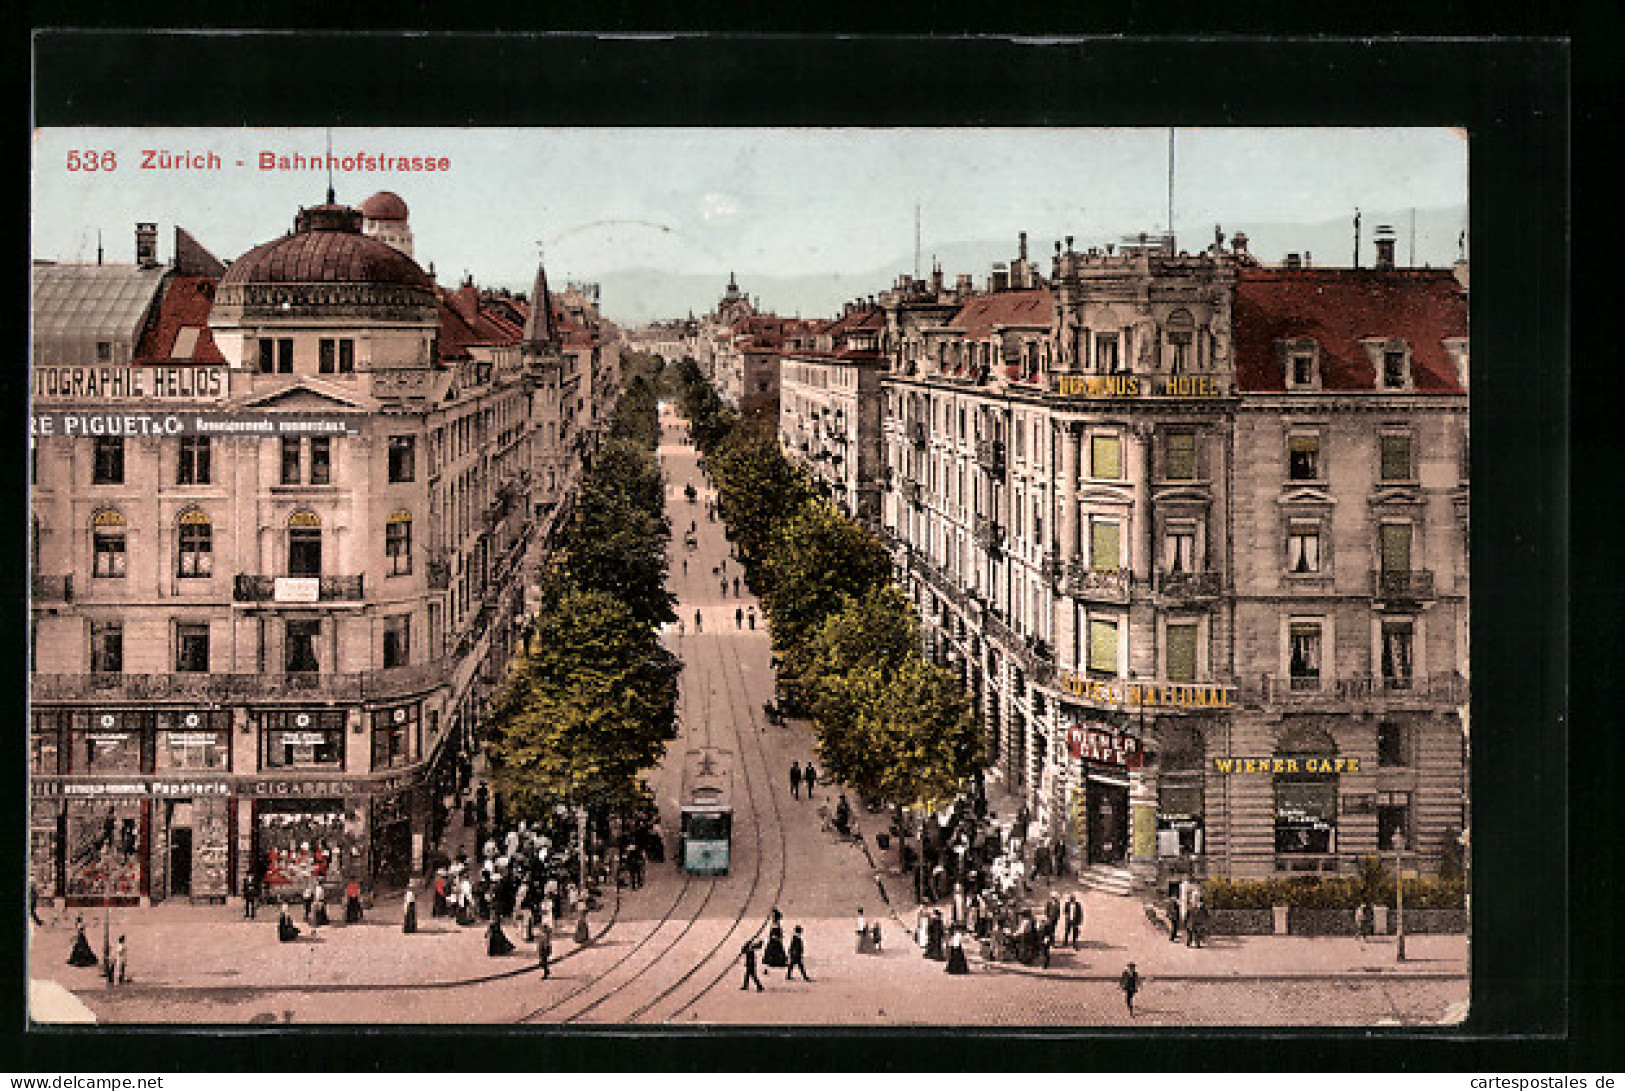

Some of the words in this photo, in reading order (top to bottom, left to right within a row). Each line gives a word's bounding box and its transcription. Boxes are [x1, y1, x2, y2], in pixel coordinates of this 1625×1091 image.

[155, 367, 221, 397] HELIOS
[1165, 375, 1219, 396] HOTEL
[1061, 675, 1118, 704] HOTEL
[1215, 757, 1299, 774] WIENER
